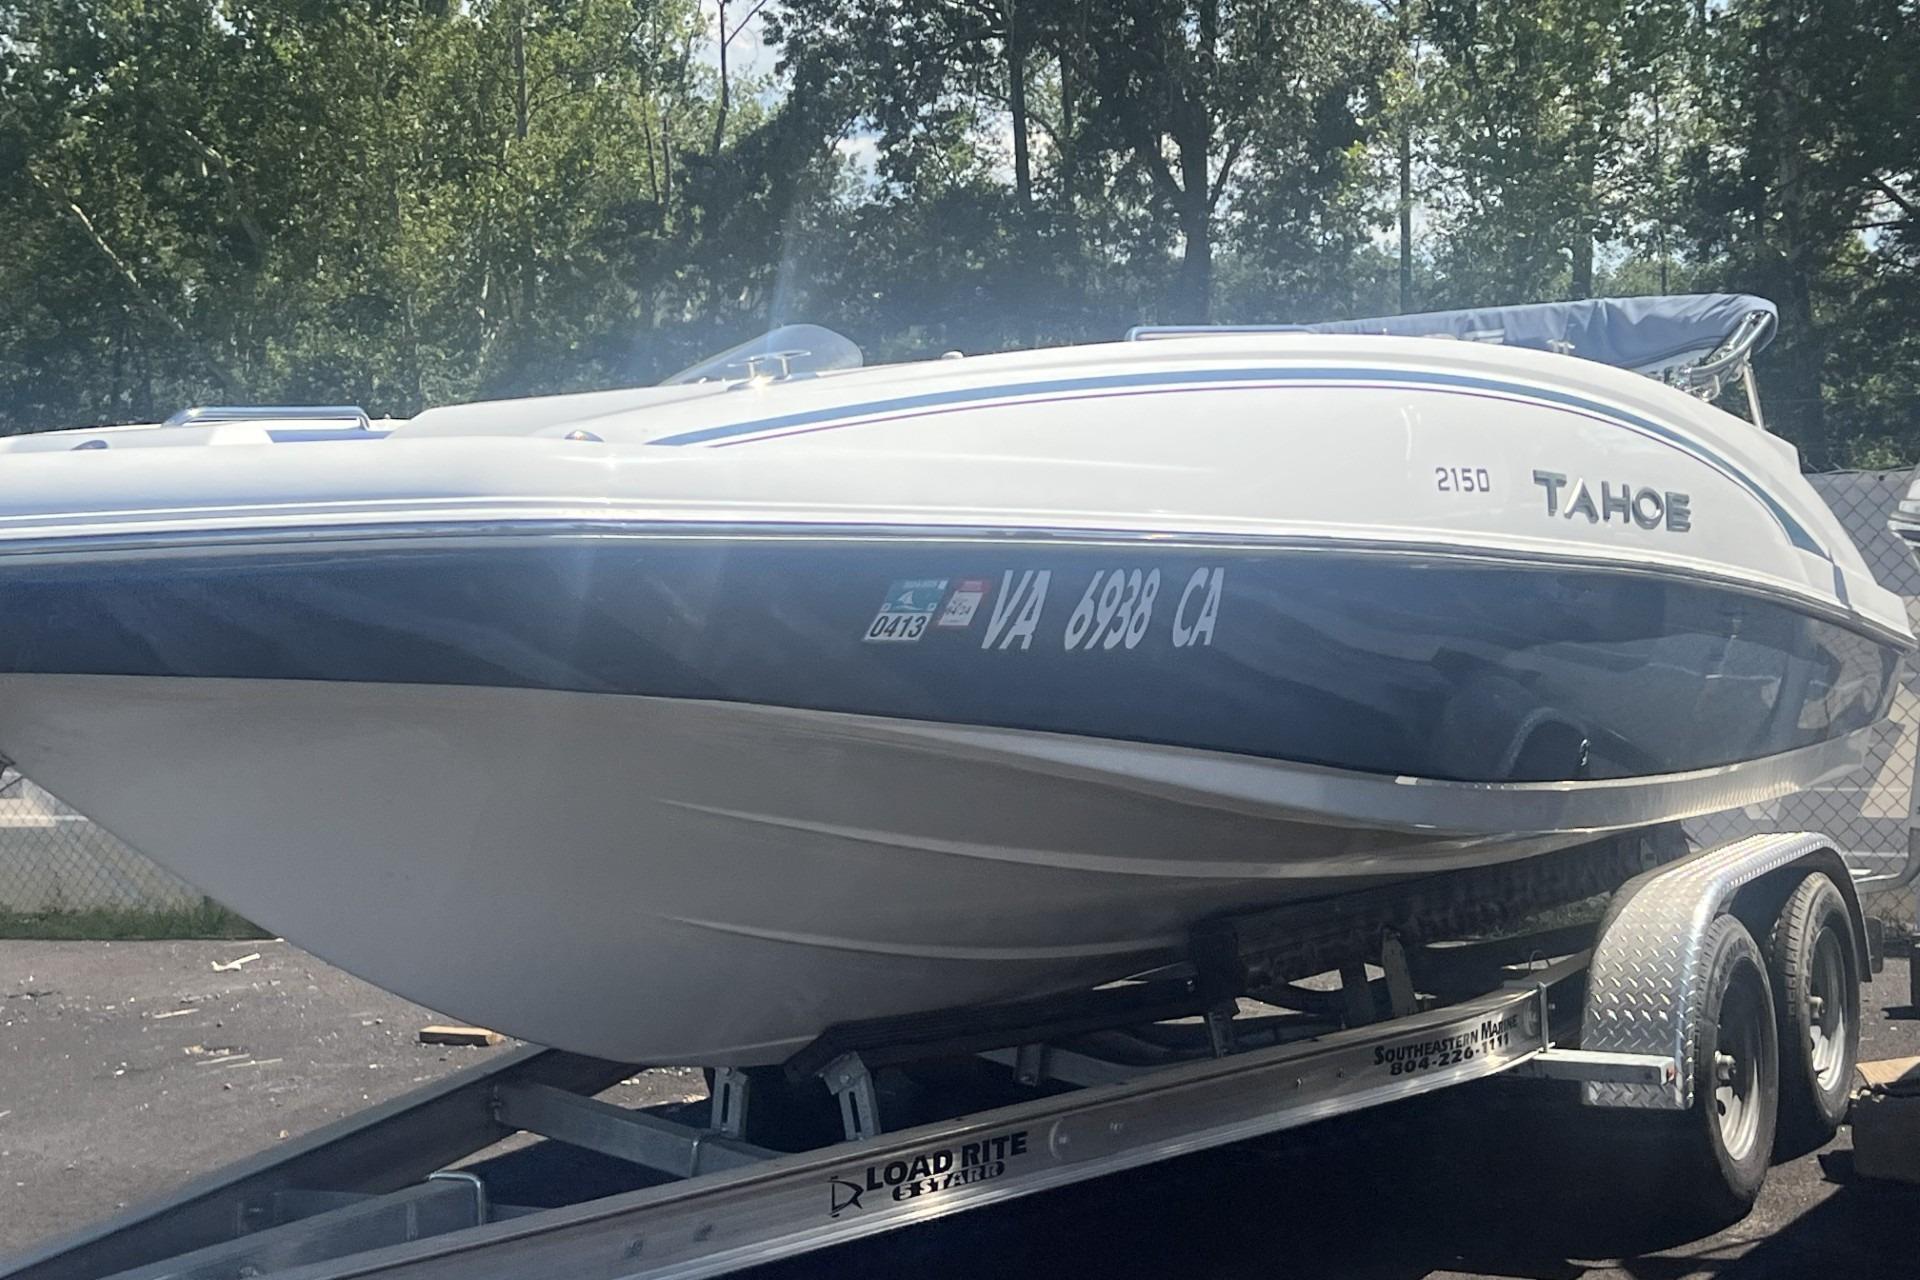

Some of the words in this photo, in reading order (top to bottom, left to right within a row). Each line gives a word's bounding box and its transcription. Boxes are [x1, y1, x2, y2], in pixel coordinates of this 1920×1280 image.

[1435, 467, 1490, 492] 2150
[1533, 470, 1691, 532] TAHOE
[869, 616, 927, 638] 0413
[981, 569, 1051, 650] VA
[1064, 567, 1160, 650] 6938
[1172, 567, 1225, 648] CA
[1390, 1033, 1510, 1076] 804-226-1111
[866, 1150, 953, 1191] LOAD
[962, 1131, 1028, 1168] RITE
